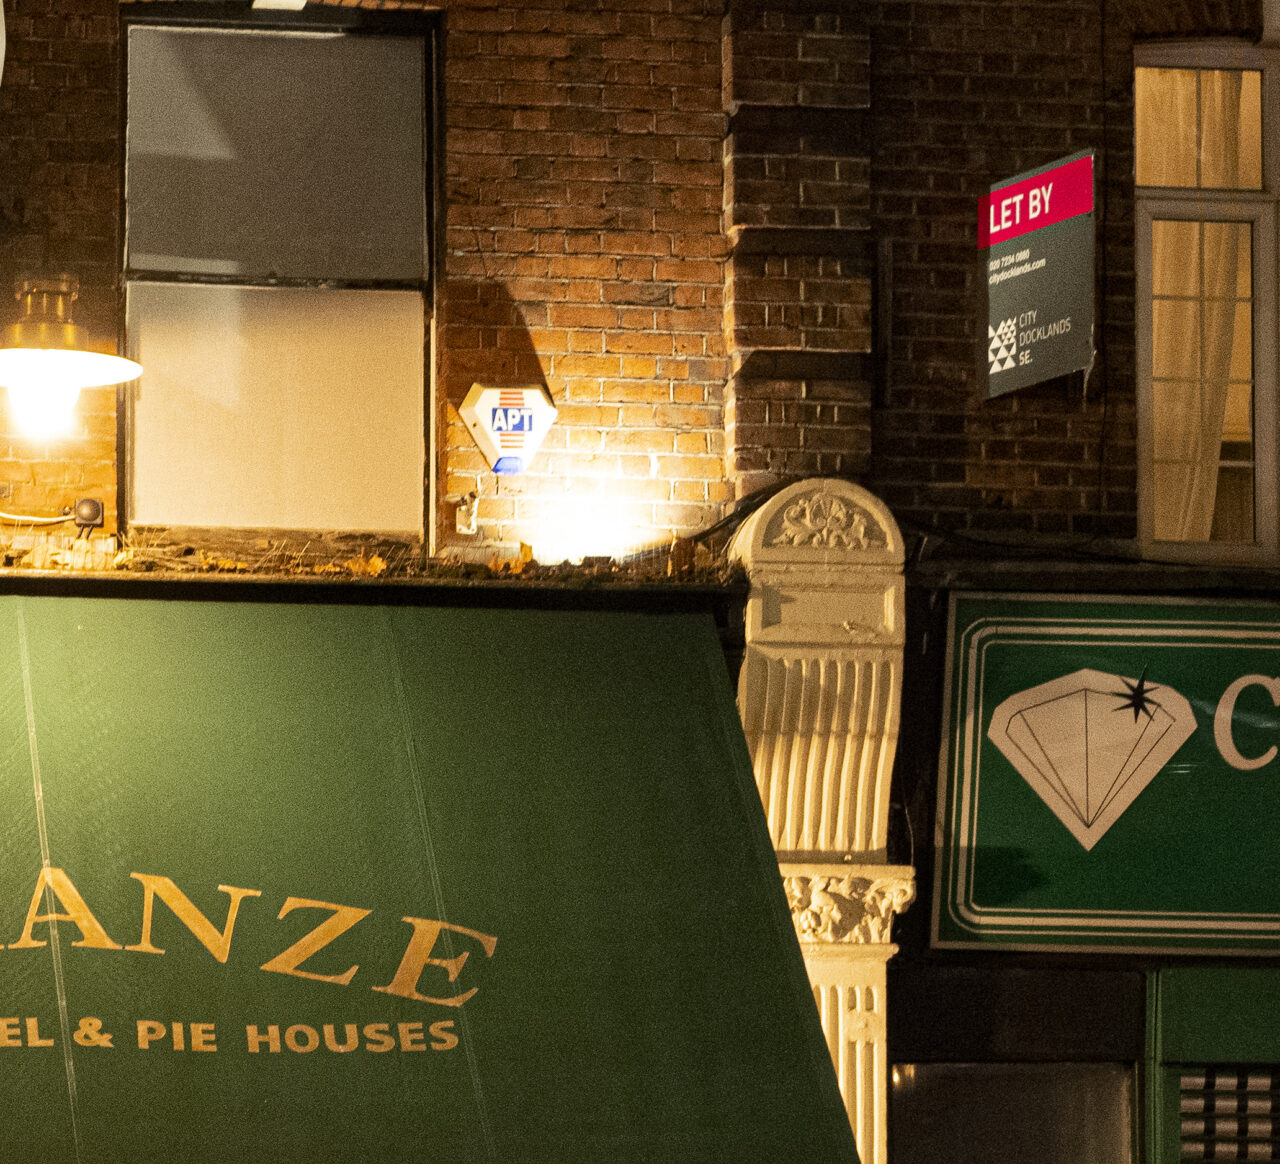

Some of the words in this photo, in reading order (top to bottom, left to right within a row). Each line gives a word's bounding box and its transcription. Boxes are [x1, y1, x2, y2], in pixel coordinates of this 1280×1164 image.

[990, 194, 1024, 234] LET
[1029, 182, 1053, 220] BY
[1019, 309, 1037, 328] CITY
[1019, 316, 1071, 346] DOCKLANDS
[492, 408, 533, 431] APT
[73, 1016, 115, 1048] &
[136, 1019, 218, 1053] PIE
[245, 1020, 460, 1054] HOUSES
